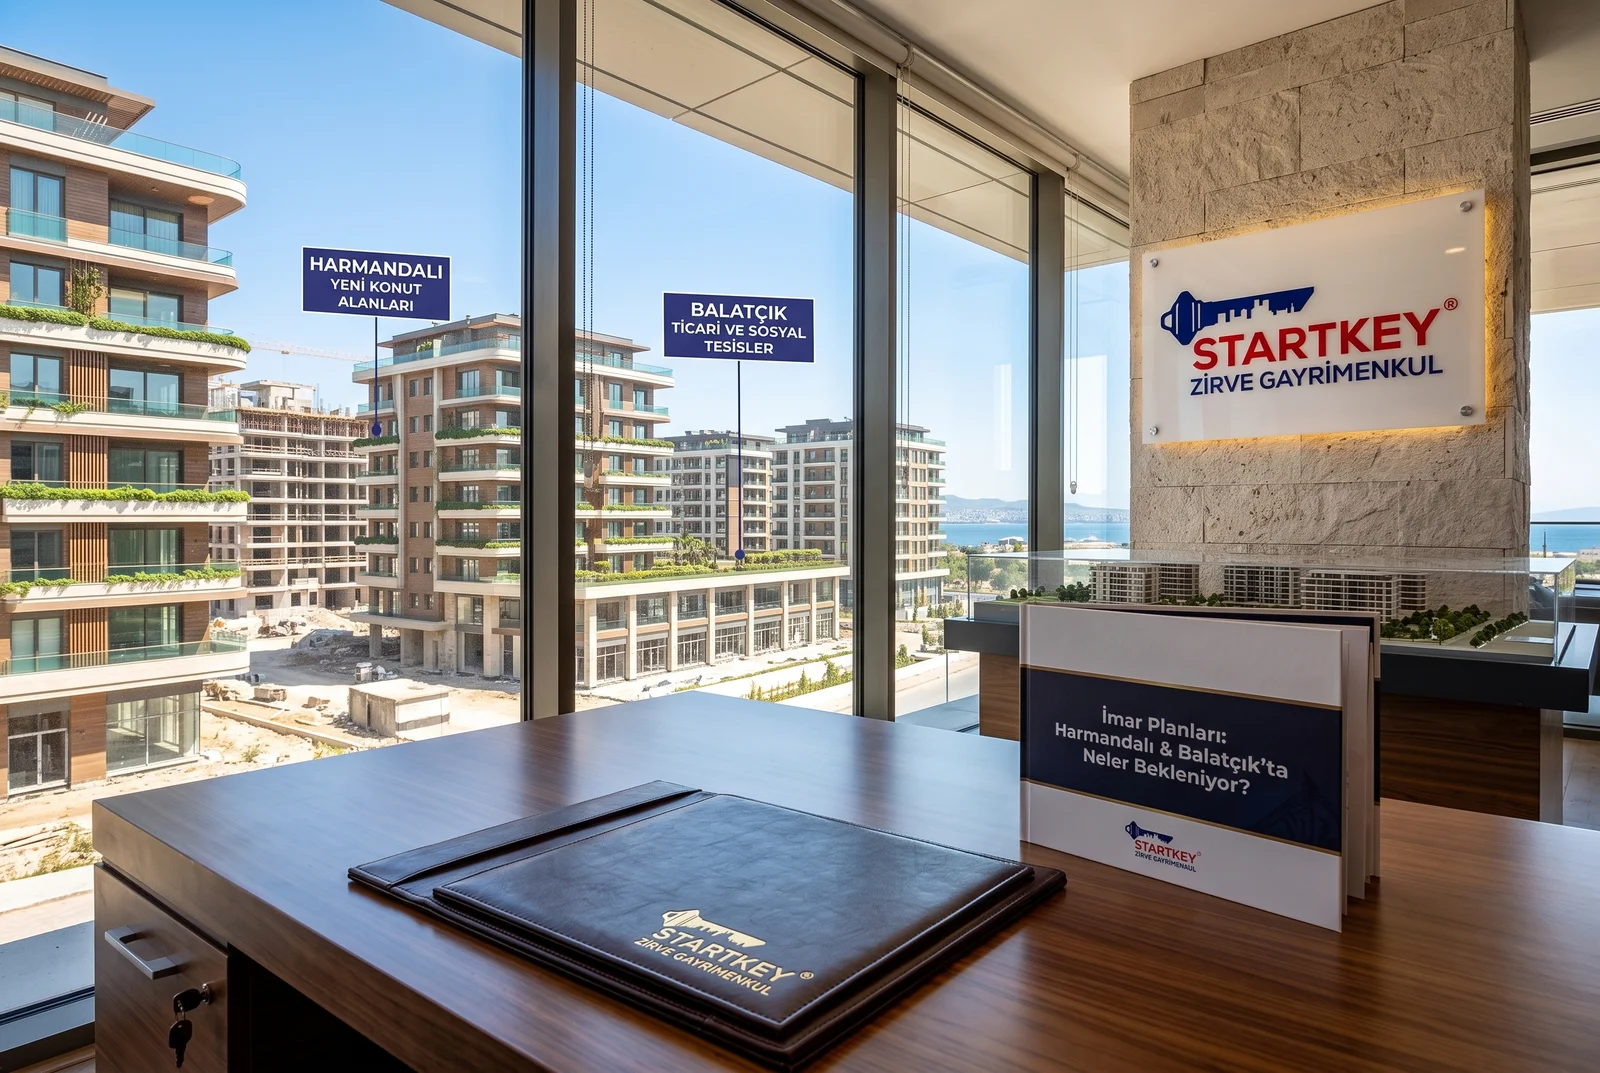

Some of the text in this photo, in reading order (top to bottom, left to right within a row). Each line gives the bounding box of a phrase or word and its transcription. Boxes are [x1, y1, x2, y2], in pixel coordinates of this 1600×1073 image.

[1190, 354, 1444, 396] ZİRVE GAYRİMENKUL
[1055, 722, 1154, 754] Harmandalı
[1159, 741, 1173, 757] &
[1102, 705, 1228, 744] İmar Planları:
[1083, 748, 1251, 795] Neler Bekleniyor?
[673, 952, 773, 996] GAYRİMENKUL
